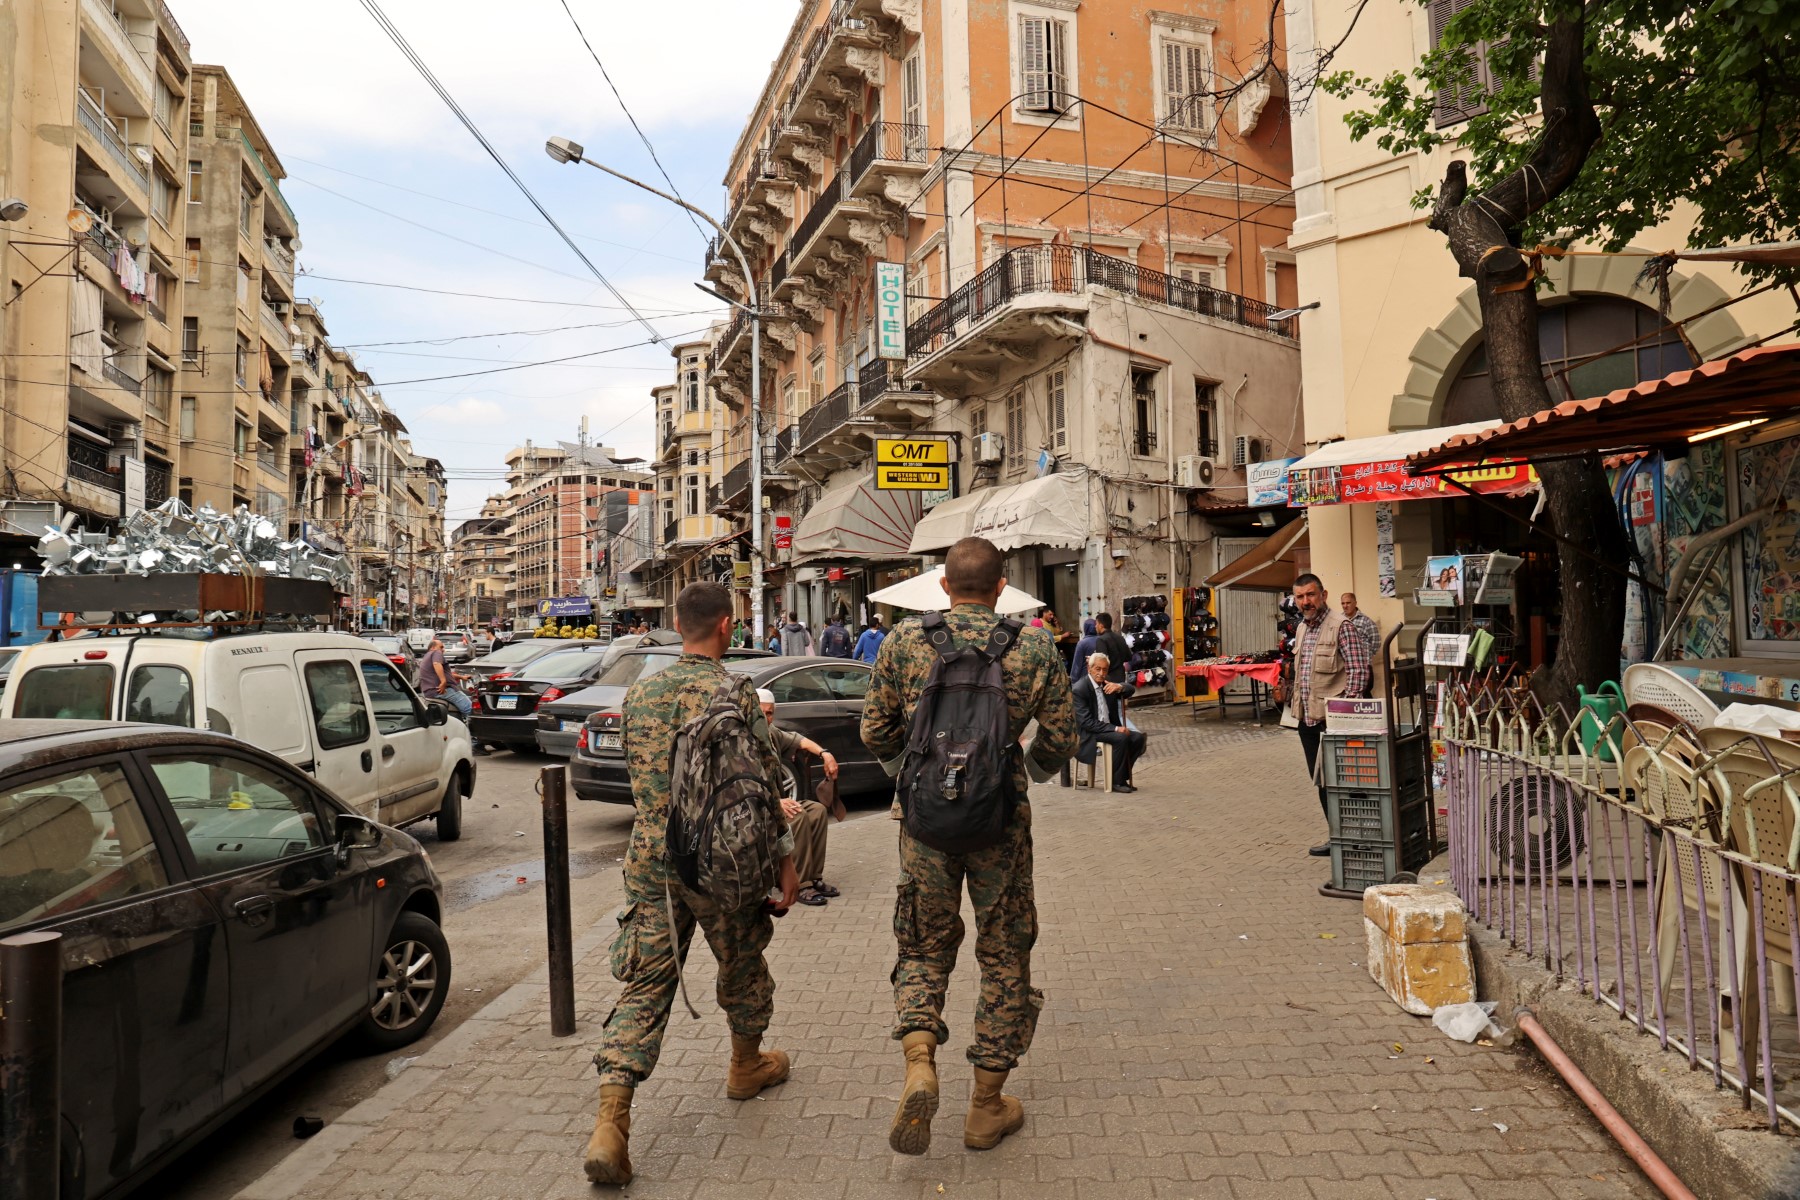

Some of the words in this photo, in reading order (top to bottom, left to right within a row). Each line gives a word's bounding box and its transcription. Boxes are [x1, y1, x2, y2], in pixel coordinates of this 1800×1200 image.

[882, 275, 901, 348] HOTEL
[891, 443, 935, 460] OMT
[1250, 467, 1281, 483] حسن
[1366, 485, 1373, 494] و
[1376, 481, 1398, 492] جملة
[1400, 475, 1436, 492] الأراكيل
[1345, 484, 1366, 496] مفرق
[230, 646, 264, 656] RENAULT
[1353, 702, 1379, 714] البيان
